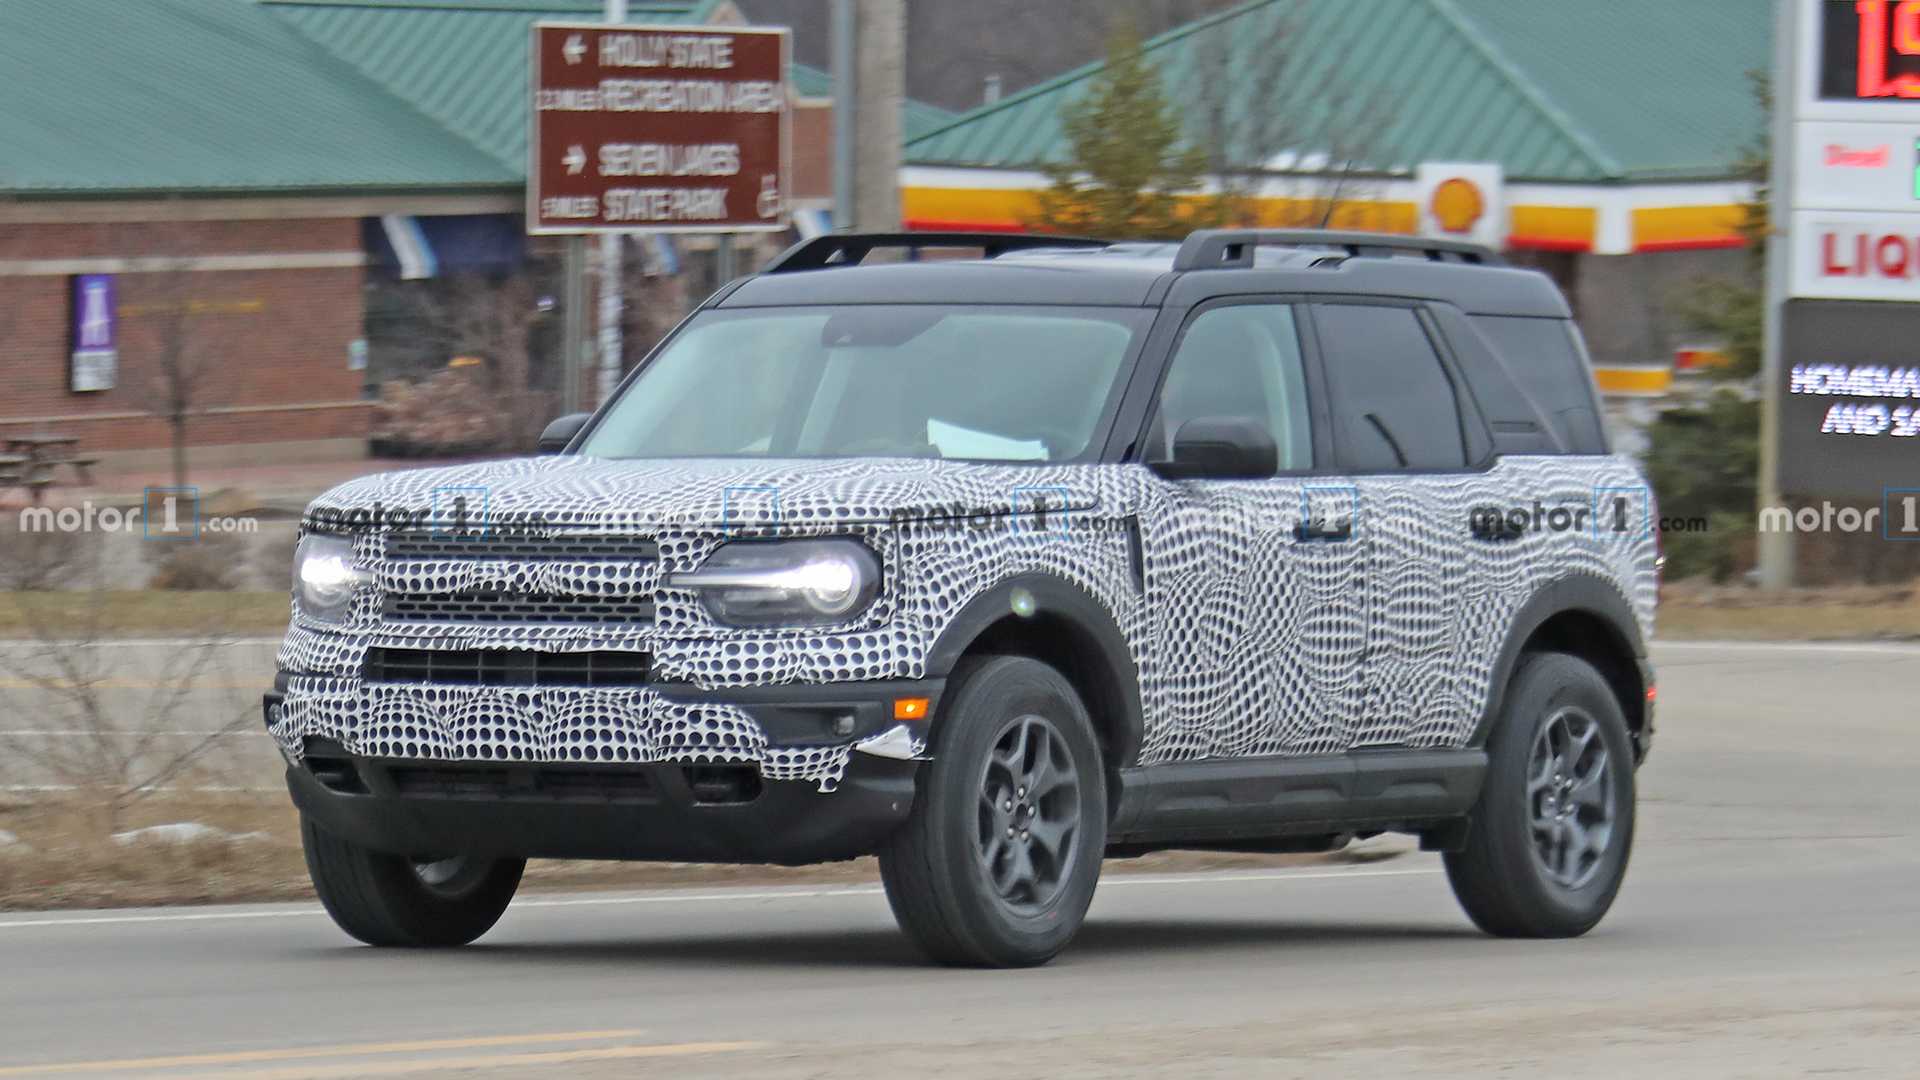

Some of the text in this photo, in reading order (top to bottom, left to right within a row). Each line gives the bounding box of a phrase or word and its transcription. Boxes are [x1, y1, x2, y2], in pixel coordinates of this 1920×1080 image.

[598, 34, 735, 68] HOLLY STATE
[600, 78, 787, 113] RECREATION AREA
[598, 143, 741, 176] SEVEN LAKES
[602, 187, 729, 221] STATE PARK
[1822, 232, 1920, 281] LIQ
[1821, 403, 1890, 436] AND
